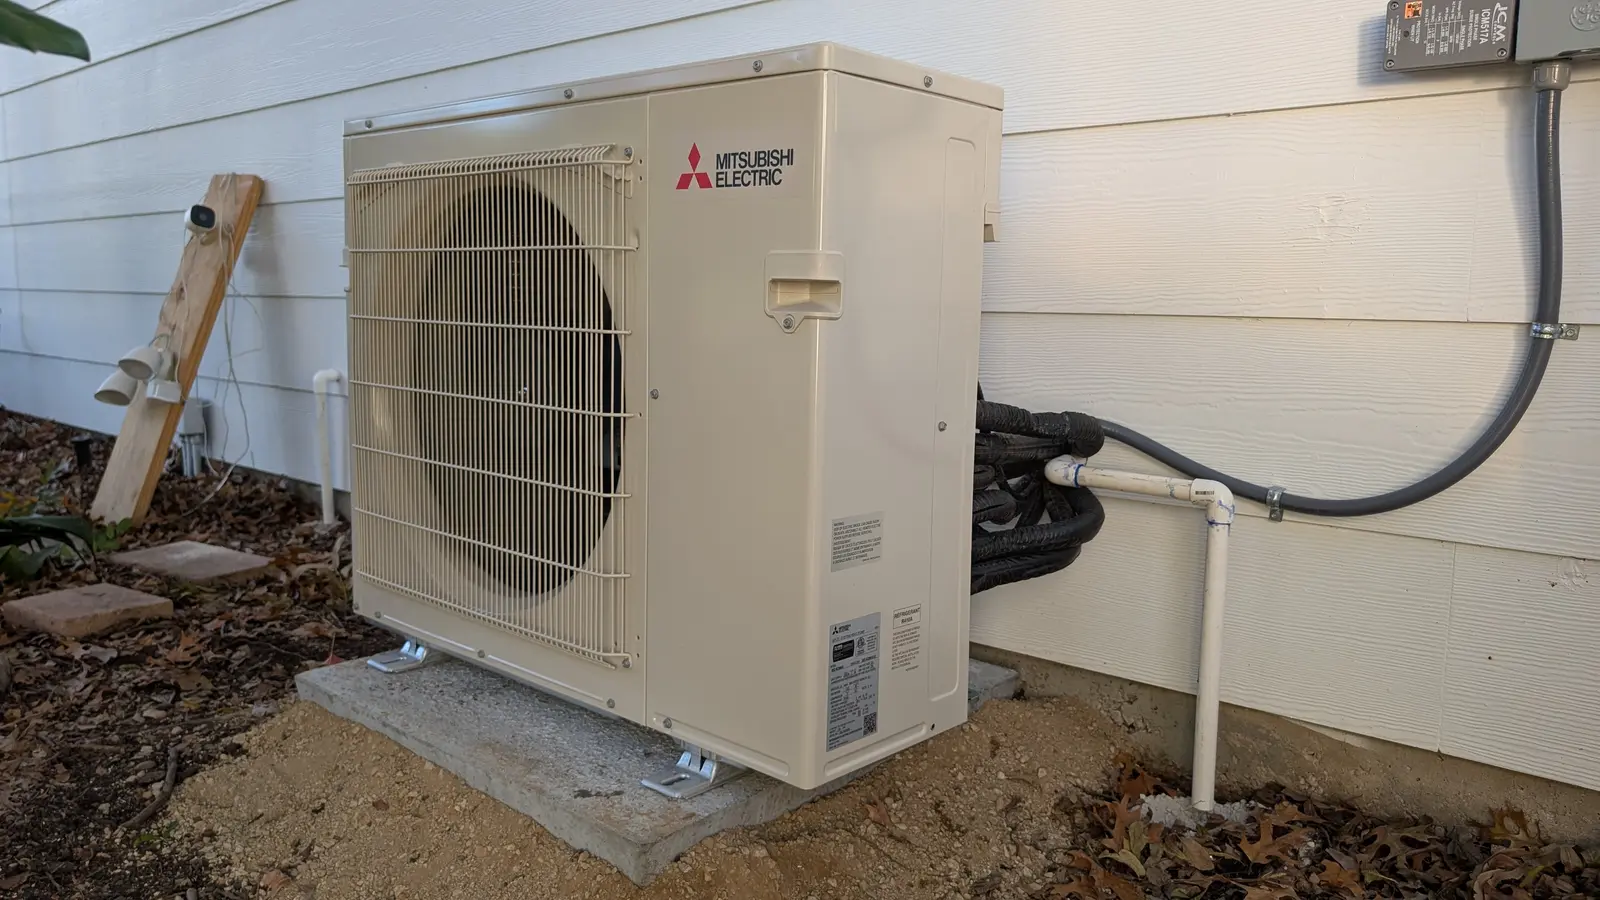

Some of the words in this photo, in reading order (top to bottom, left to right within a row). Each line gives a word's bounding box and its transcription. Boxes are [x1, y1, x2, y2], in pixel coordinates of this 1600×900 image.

[1479, 8, 1491, 44] ICM517A
[1495, 6, 1508, 41] ICM
[716, 148, 794, 170] MITSUBISHI
[716, 168, 782, 188] ELECTRIC
